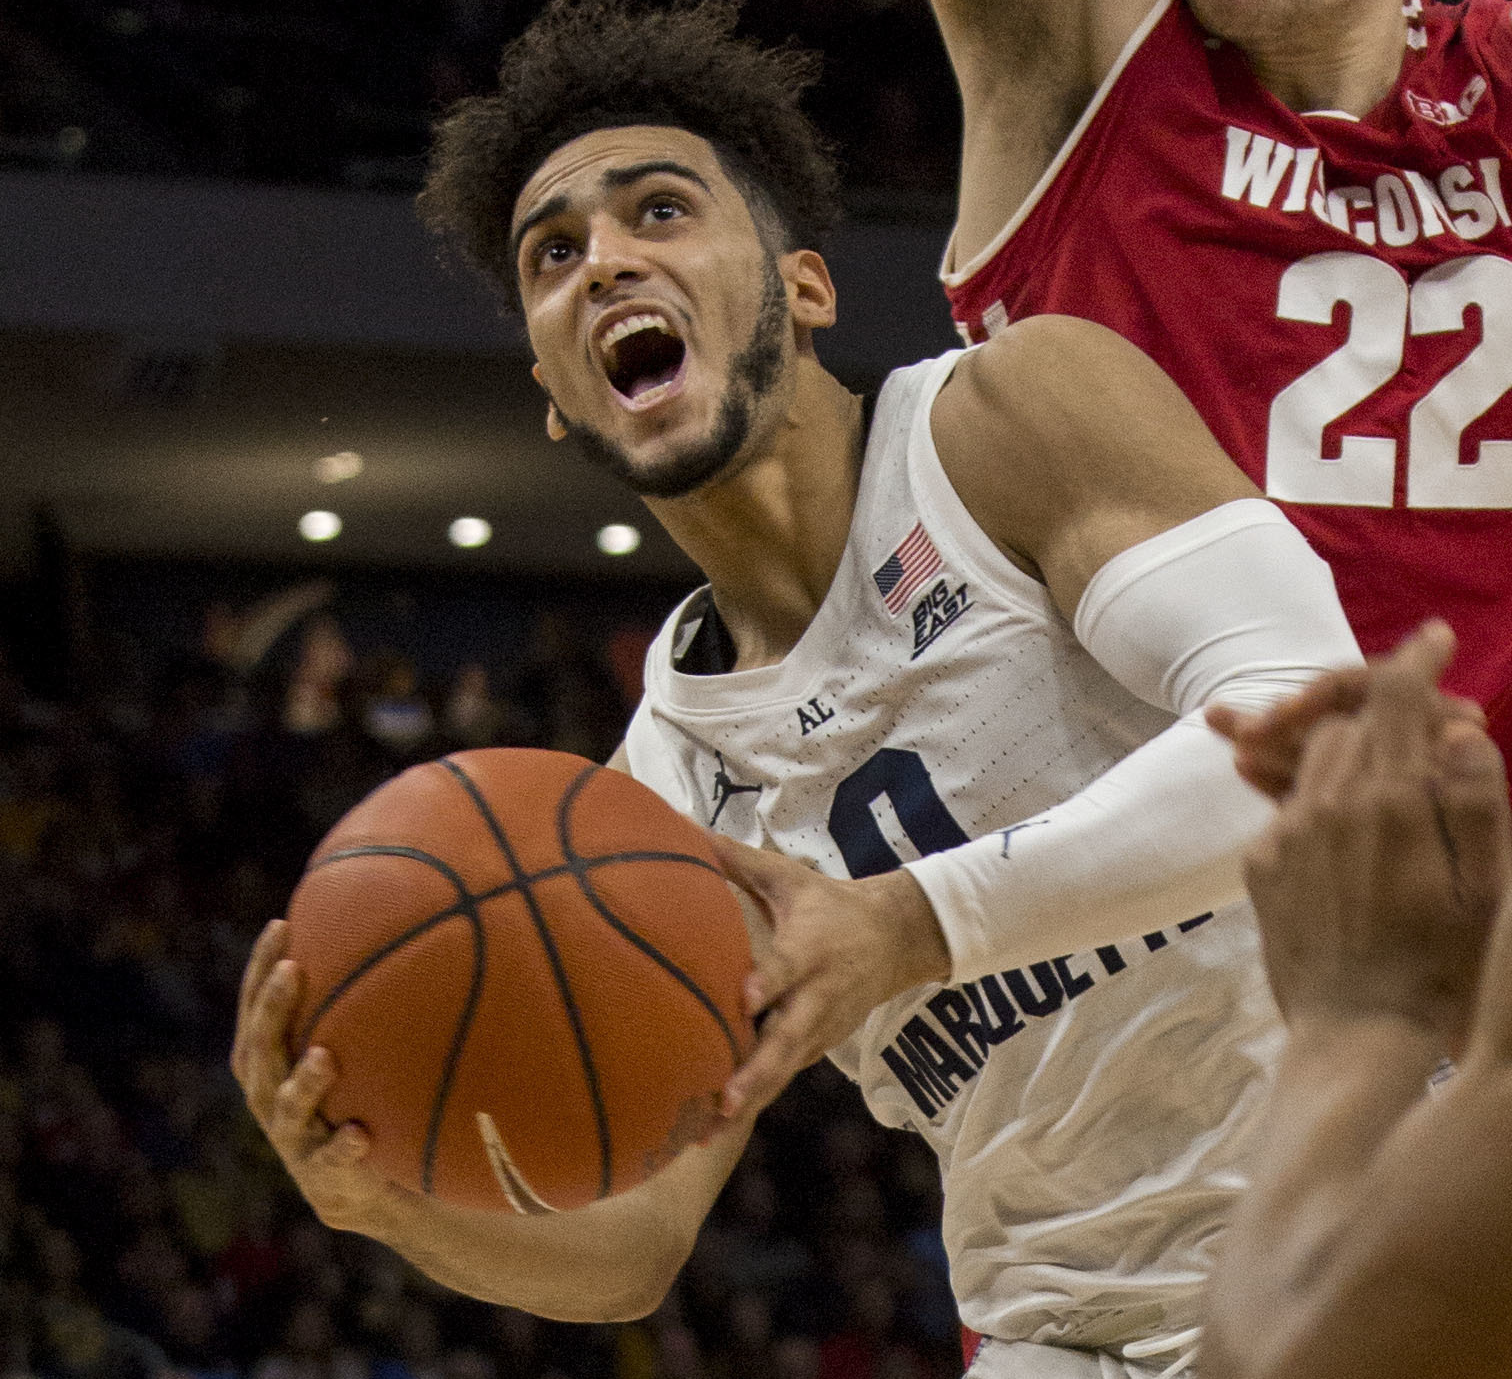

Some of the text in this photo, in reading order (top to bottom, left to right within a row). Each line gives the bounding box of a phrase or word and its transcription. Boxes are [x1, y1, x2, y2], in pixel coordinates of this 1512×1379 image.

[912, 579, 949, 633] BIG
[914, 583, 968, 650] EAST
[797, 697, 835, 736] AL
